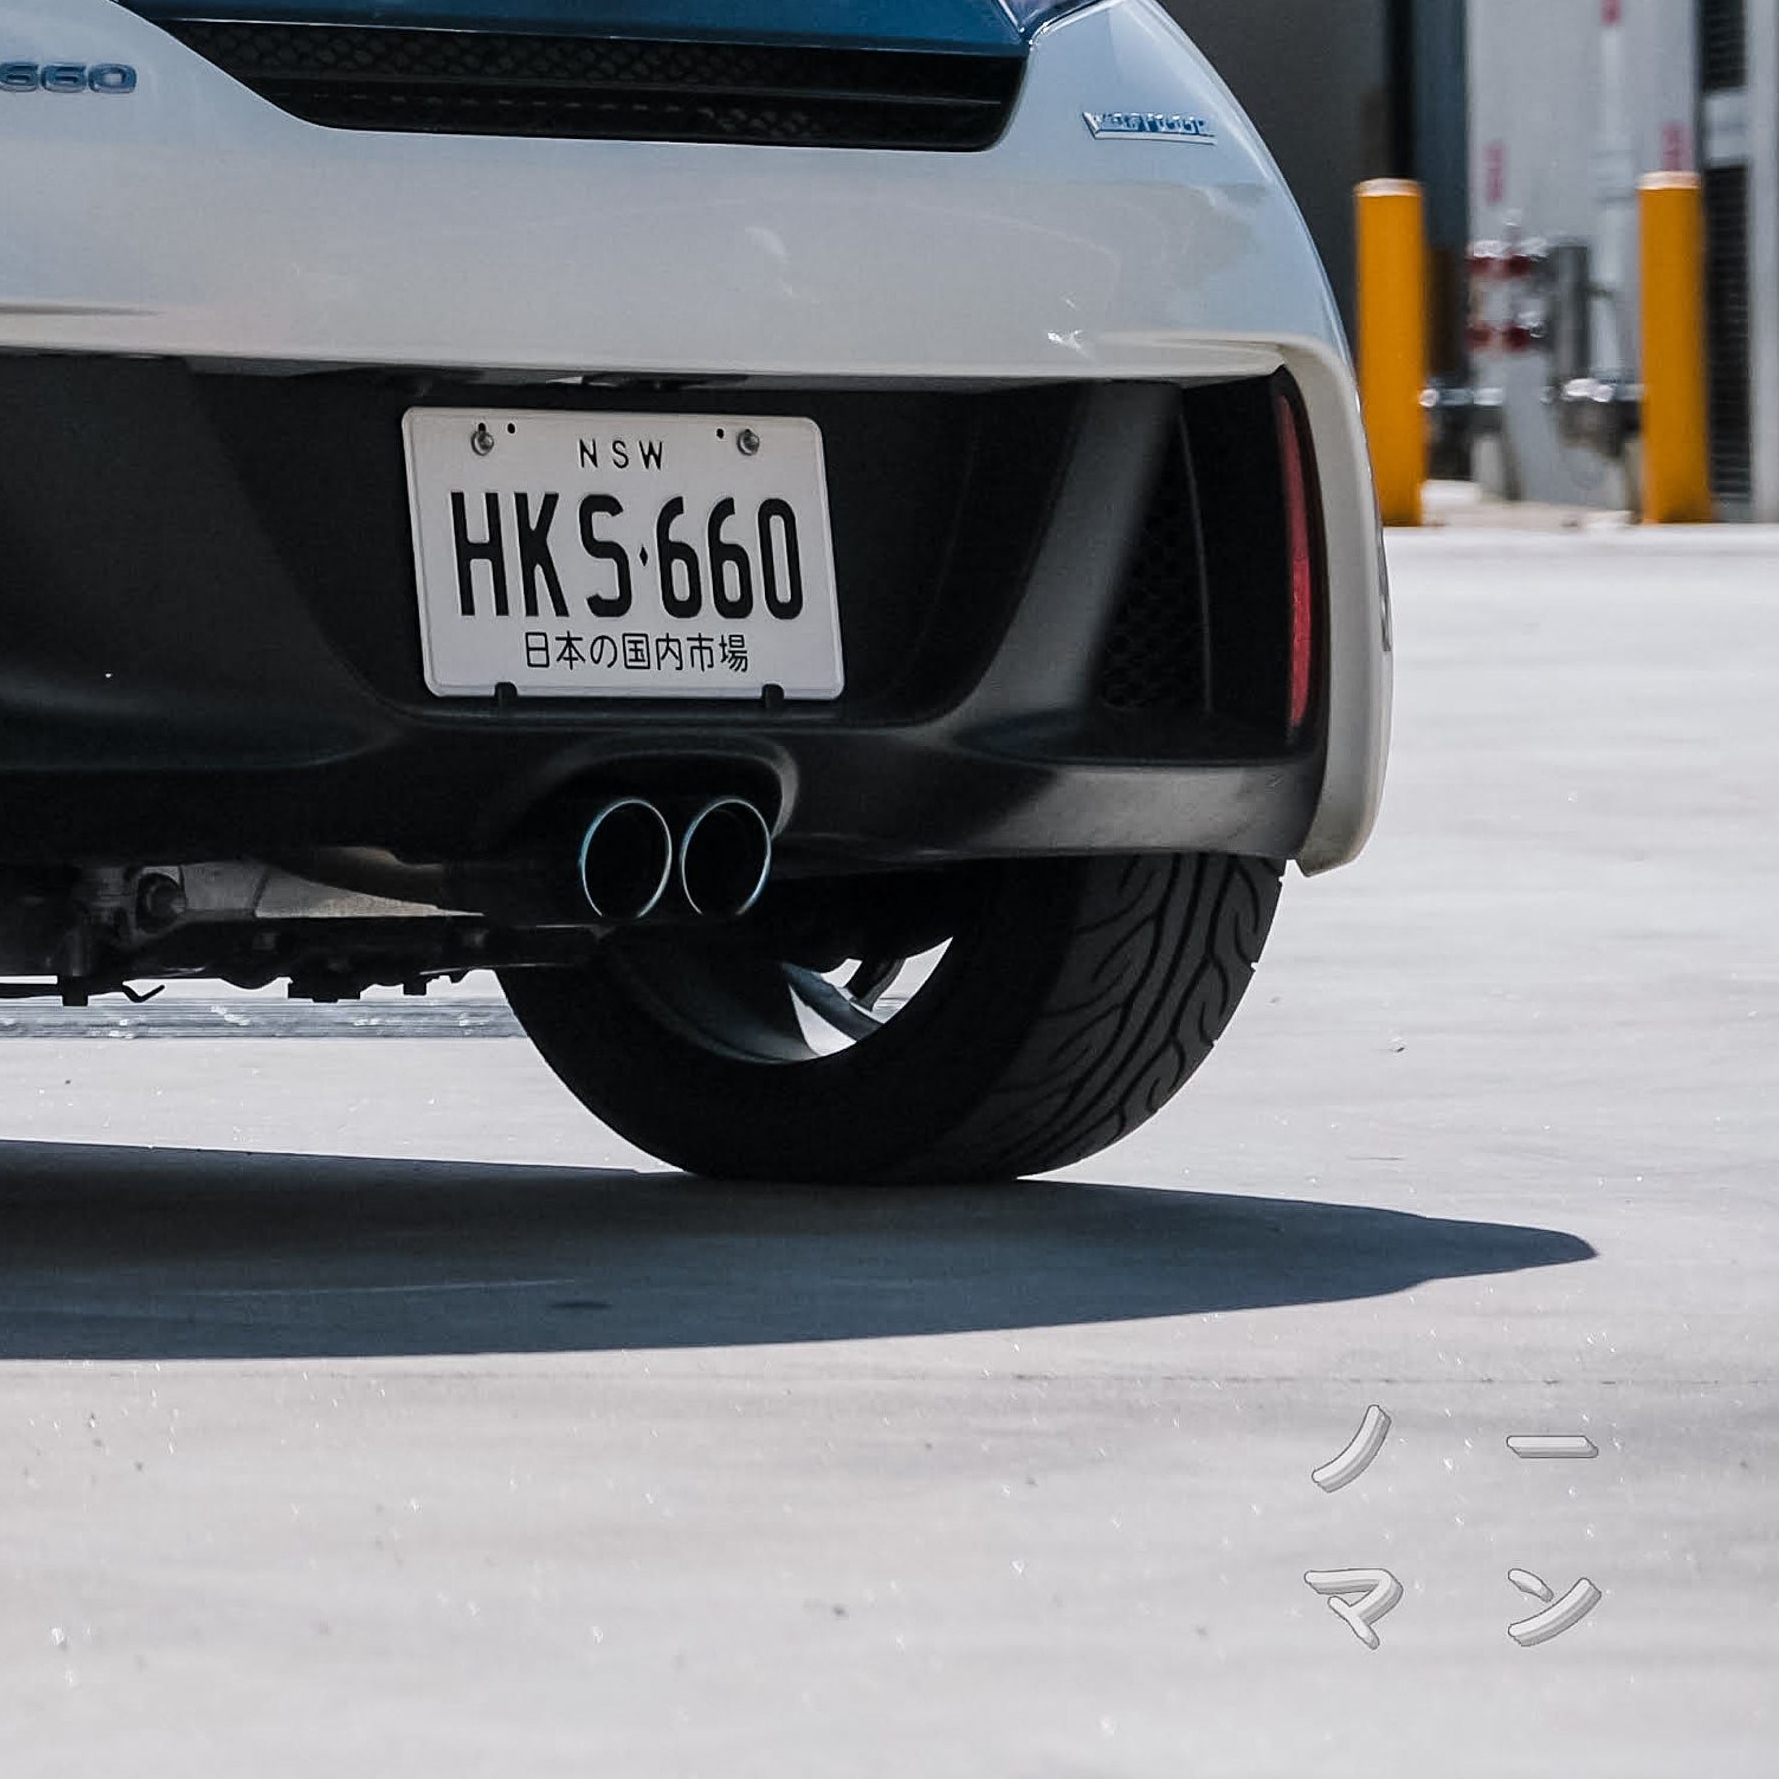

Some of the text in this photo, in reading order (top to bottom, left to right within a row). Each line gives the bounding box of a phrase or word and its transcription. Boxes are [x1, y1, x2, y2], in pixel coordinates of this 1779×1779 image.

[579, 438, 664, 470] NSW
[524, 630, 749, 674] 日本の国内市場
